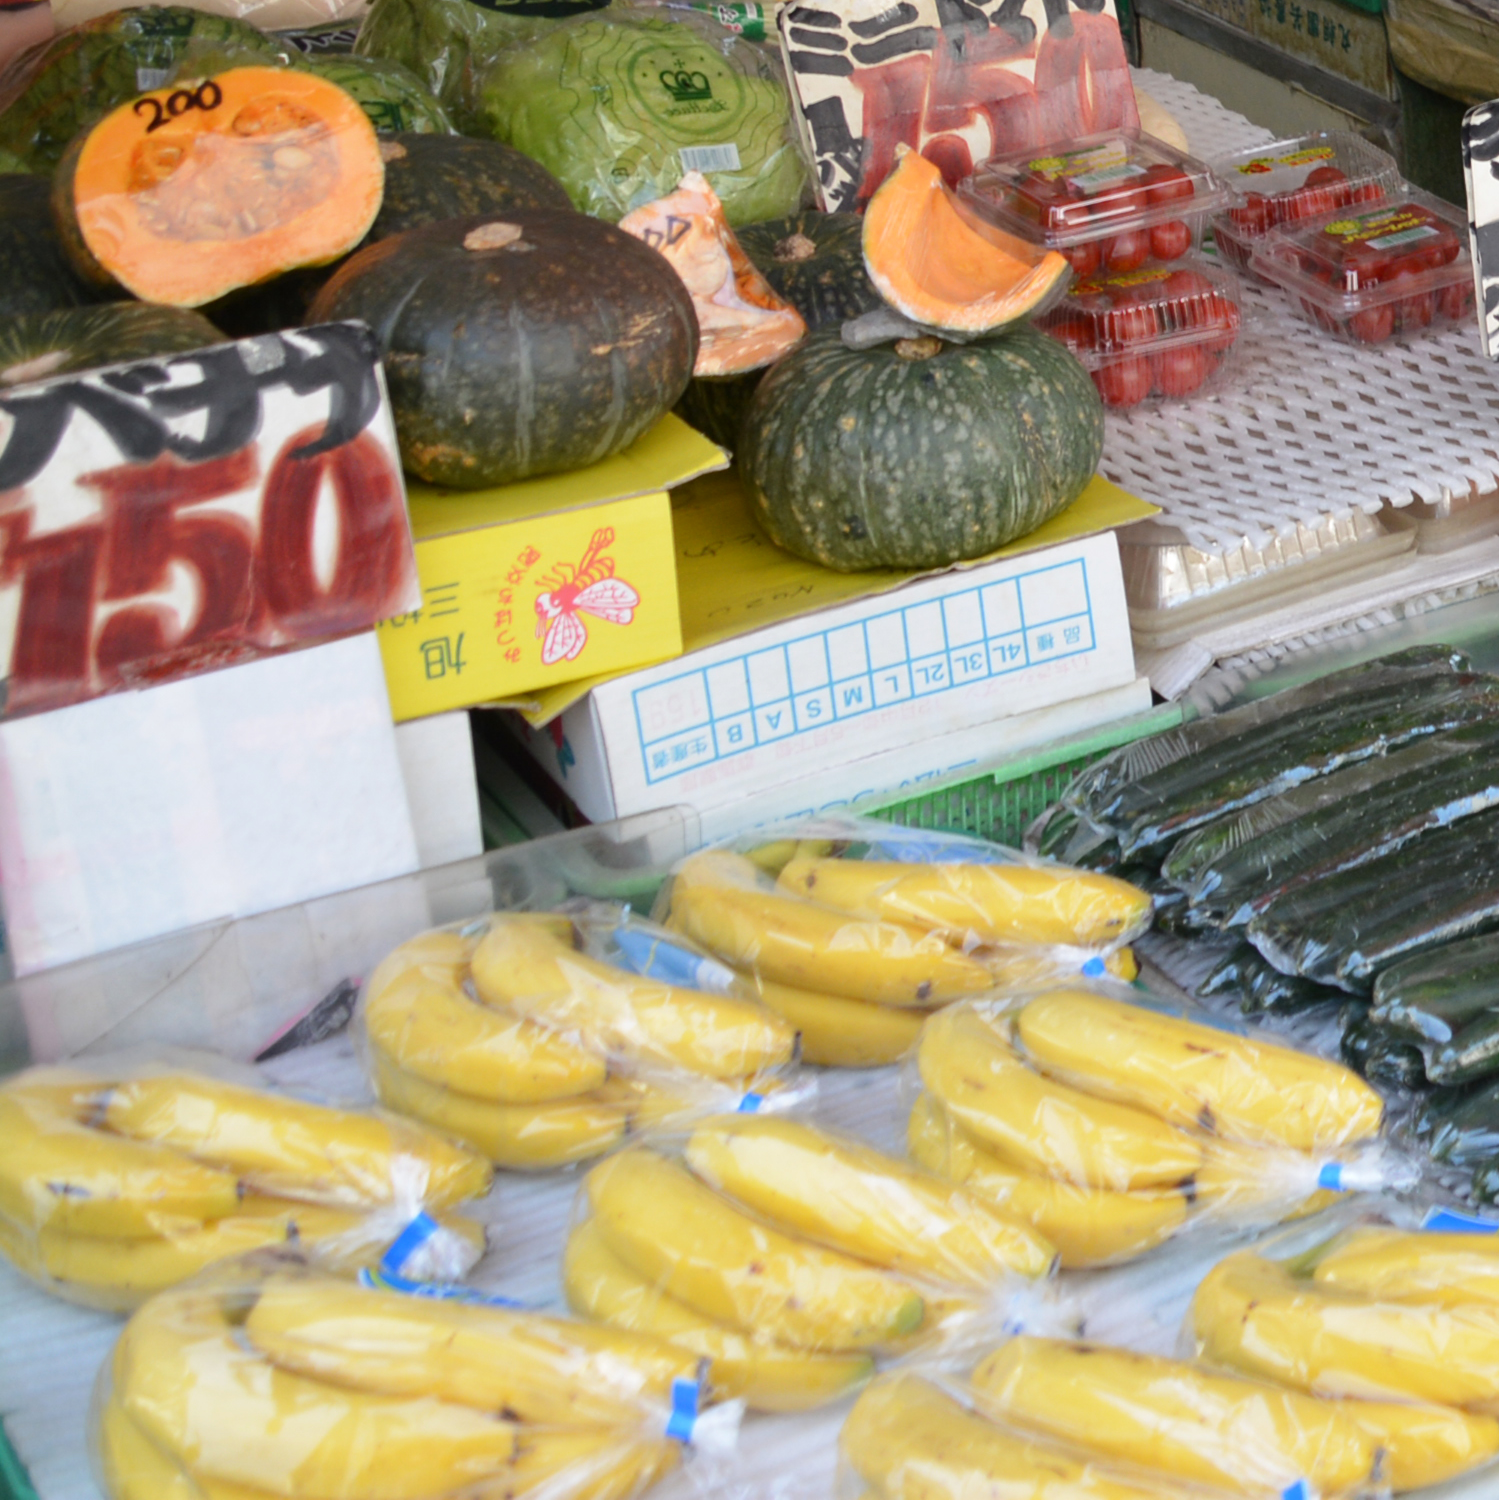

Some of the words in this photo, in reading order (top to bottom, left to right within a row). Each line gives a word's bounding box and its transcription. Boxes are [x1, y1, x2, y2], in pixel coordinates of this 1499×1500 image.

[133, 79, 223, 134] 200
[851, 10, 1140, 202] 150
[0, 422, 404, 702] 150
[952, 651, 985, 672] 3L
[992, 641, 1021, 665] 4L
[915, 661, 946, 684] 2L
[842, 684, 864, 705] M
[884, 675, 898, 695] L
[766, 709, 783, 729] A
[807, 697, 823, 719] S
[725, 723, 743, 744] B
